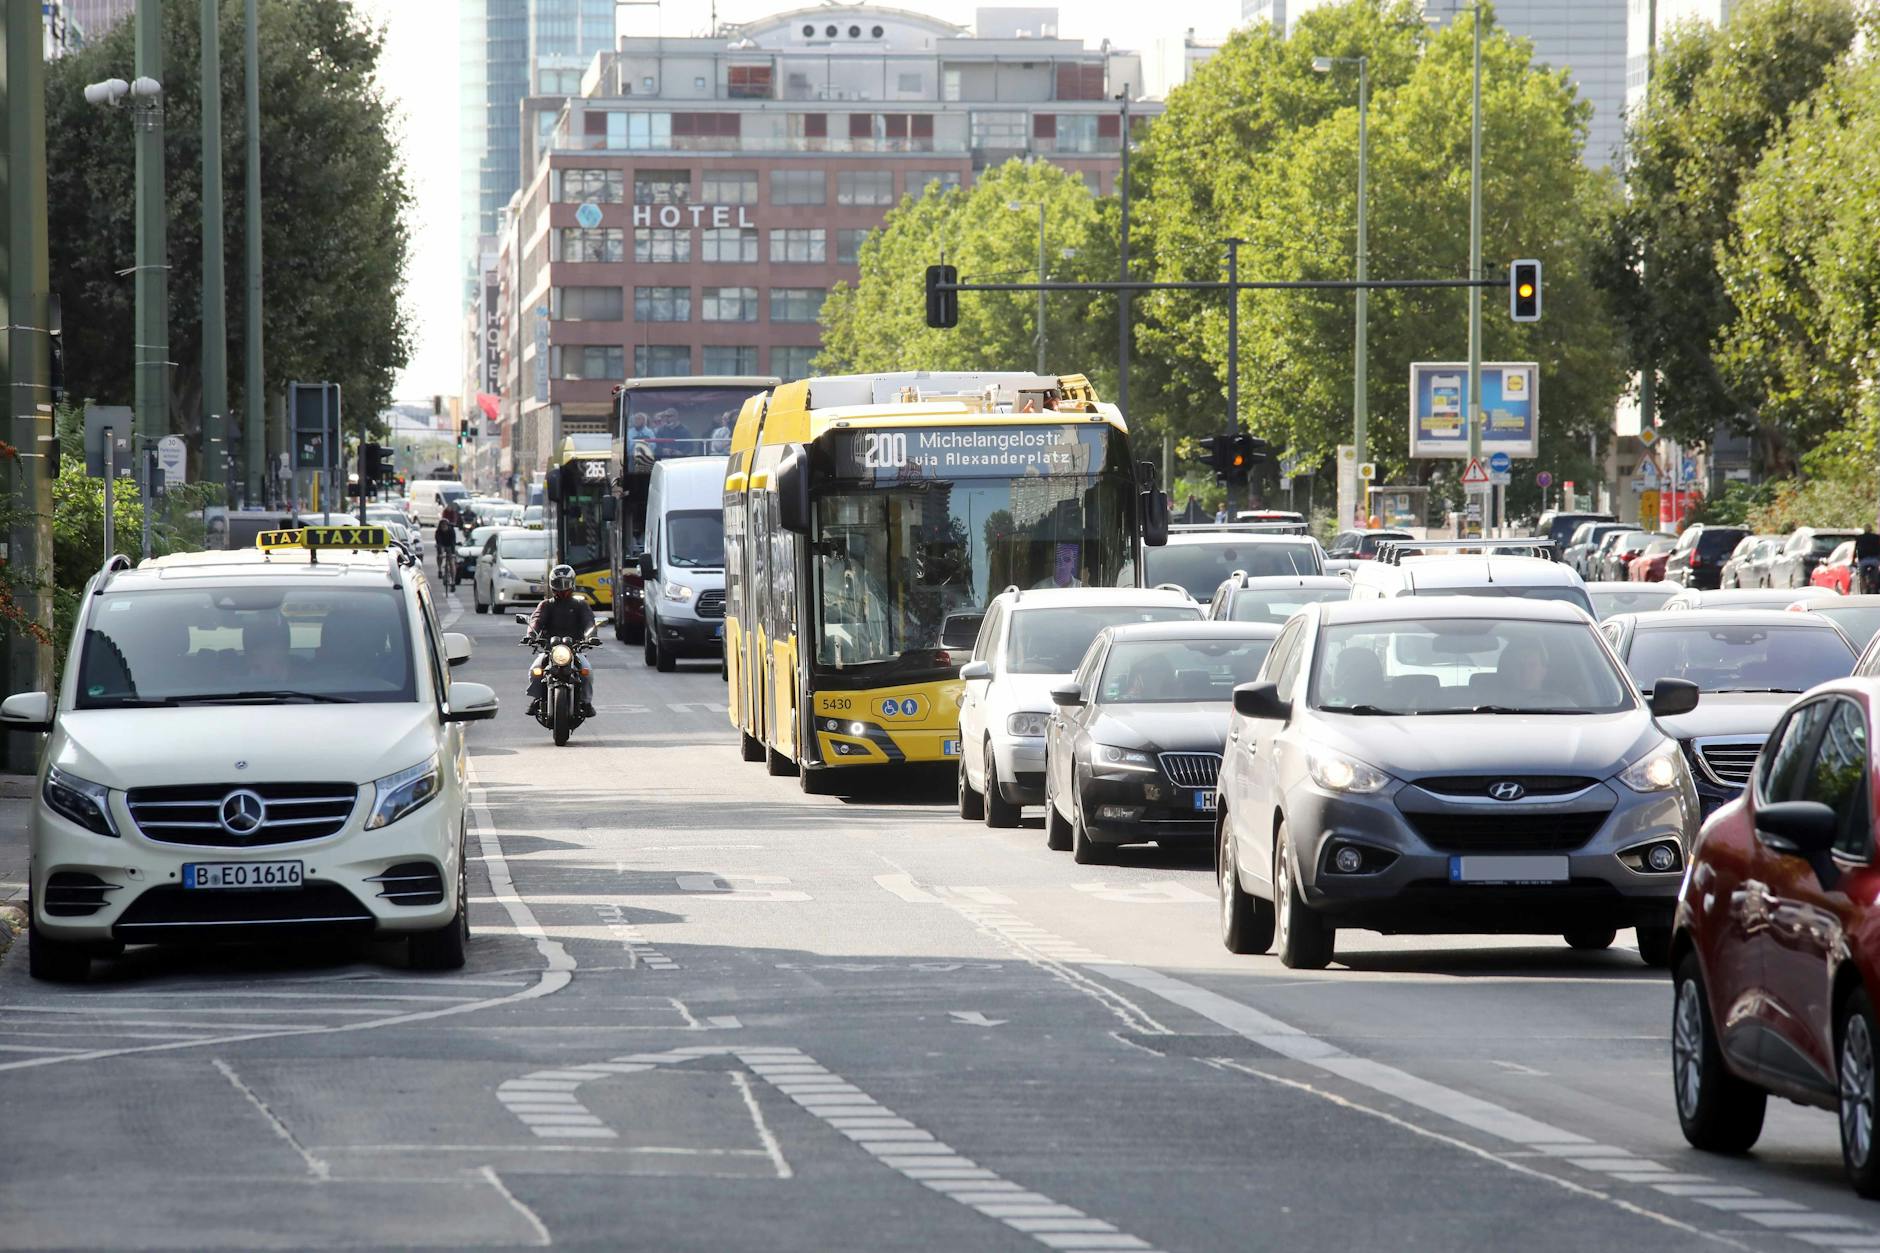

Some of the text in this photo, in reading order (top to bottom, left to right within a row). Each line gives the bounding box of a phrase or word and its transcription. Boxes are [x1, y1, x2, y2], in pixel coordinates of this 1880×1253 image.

[633, 205, 755, 228] HOTEL
[864, 430, 1066, 467] 200 Michelangelostr.
[914, 450, 1071, 466] via Alexanderplatz
[585, 461, 606, 478] 265
[316, 530, 374, 545] TAXI
[822, 698, 852, 710] 5430
[196, 865, 300, 886] B EO 1616
